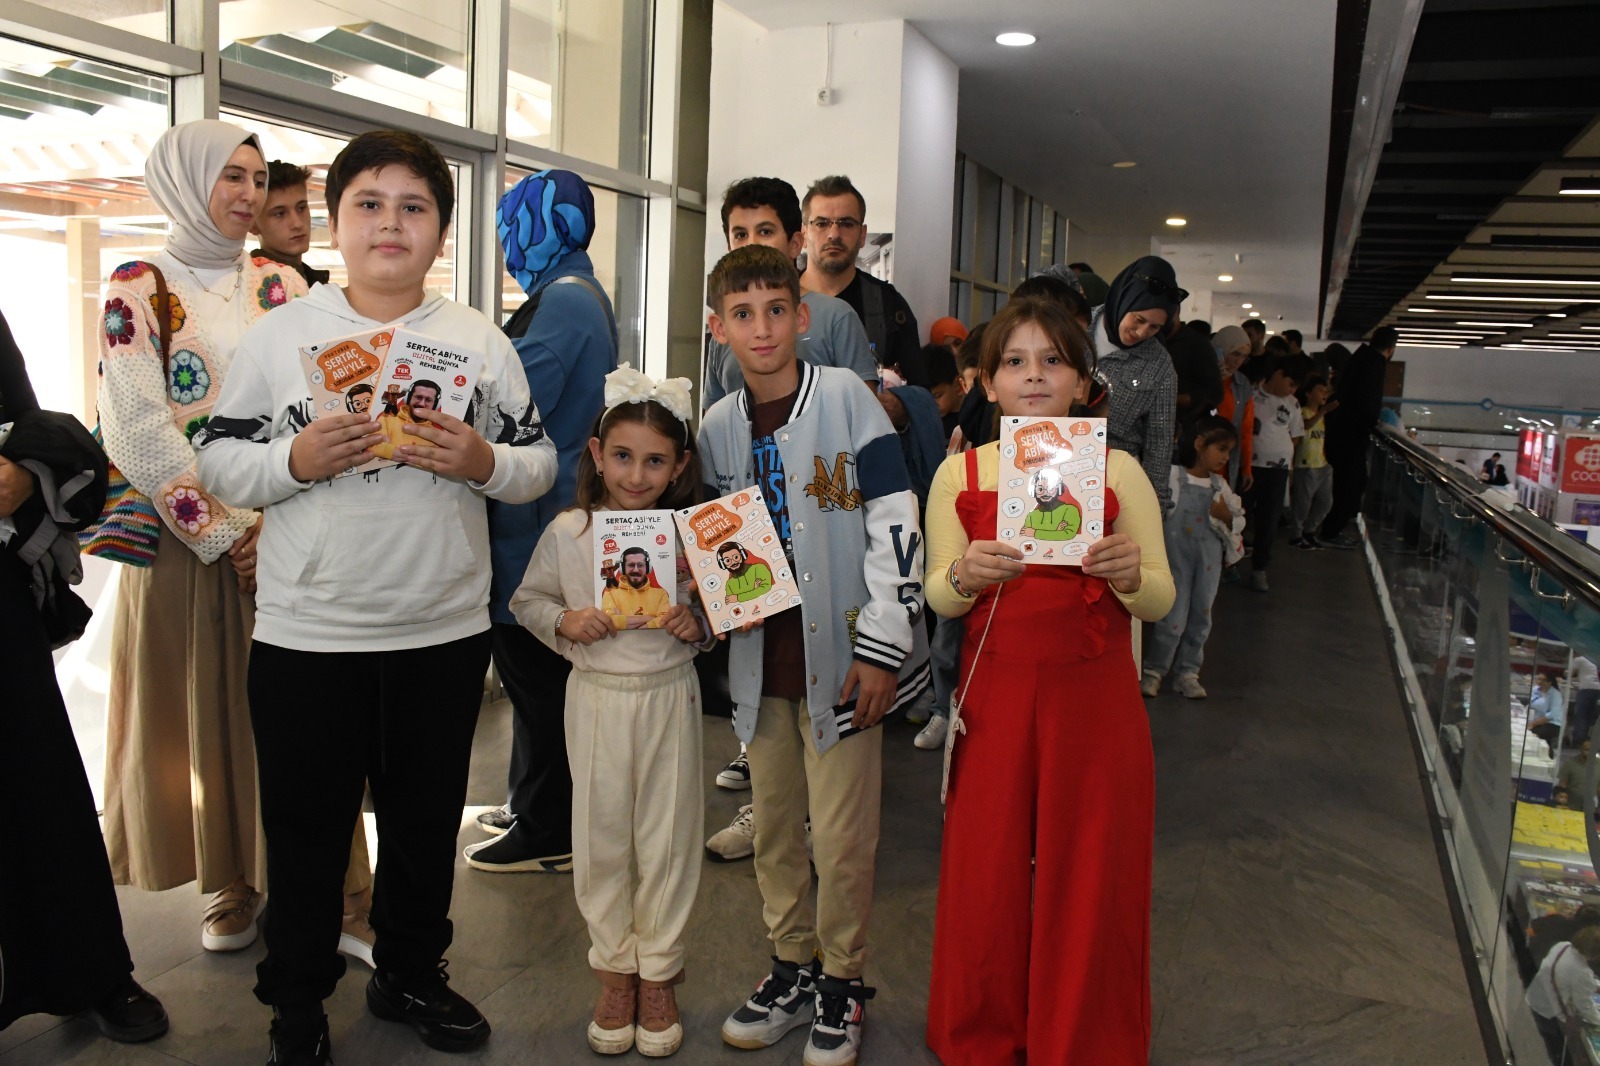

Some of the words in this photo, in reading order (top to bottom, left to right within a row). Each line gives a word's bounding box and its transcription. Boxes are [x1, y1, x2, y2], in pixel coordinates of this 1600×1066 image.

[324, 348, 359, 370] SERTAÇ
[406, 341, 438, 356] SERTAÇ
[437, 350, 469, 364] ABİ'YLE
[332, 357, 367, 381] ABİ'YLE
[419, 360, 447, 373] REHBERİ
[437, 358, 459, 369] DÜNYA
[1020, 430, 1056, 447] SERTAÇ
[1571, 471, 1600, 482] ÇOC
[606, 517, 633, 525] SERTAÇ
[633, 515, 661, 524] ABİ'YLE
[695, 509, 724, 531] SERTAÇ
[702, 517, 732, 540] ABİ'YLE
